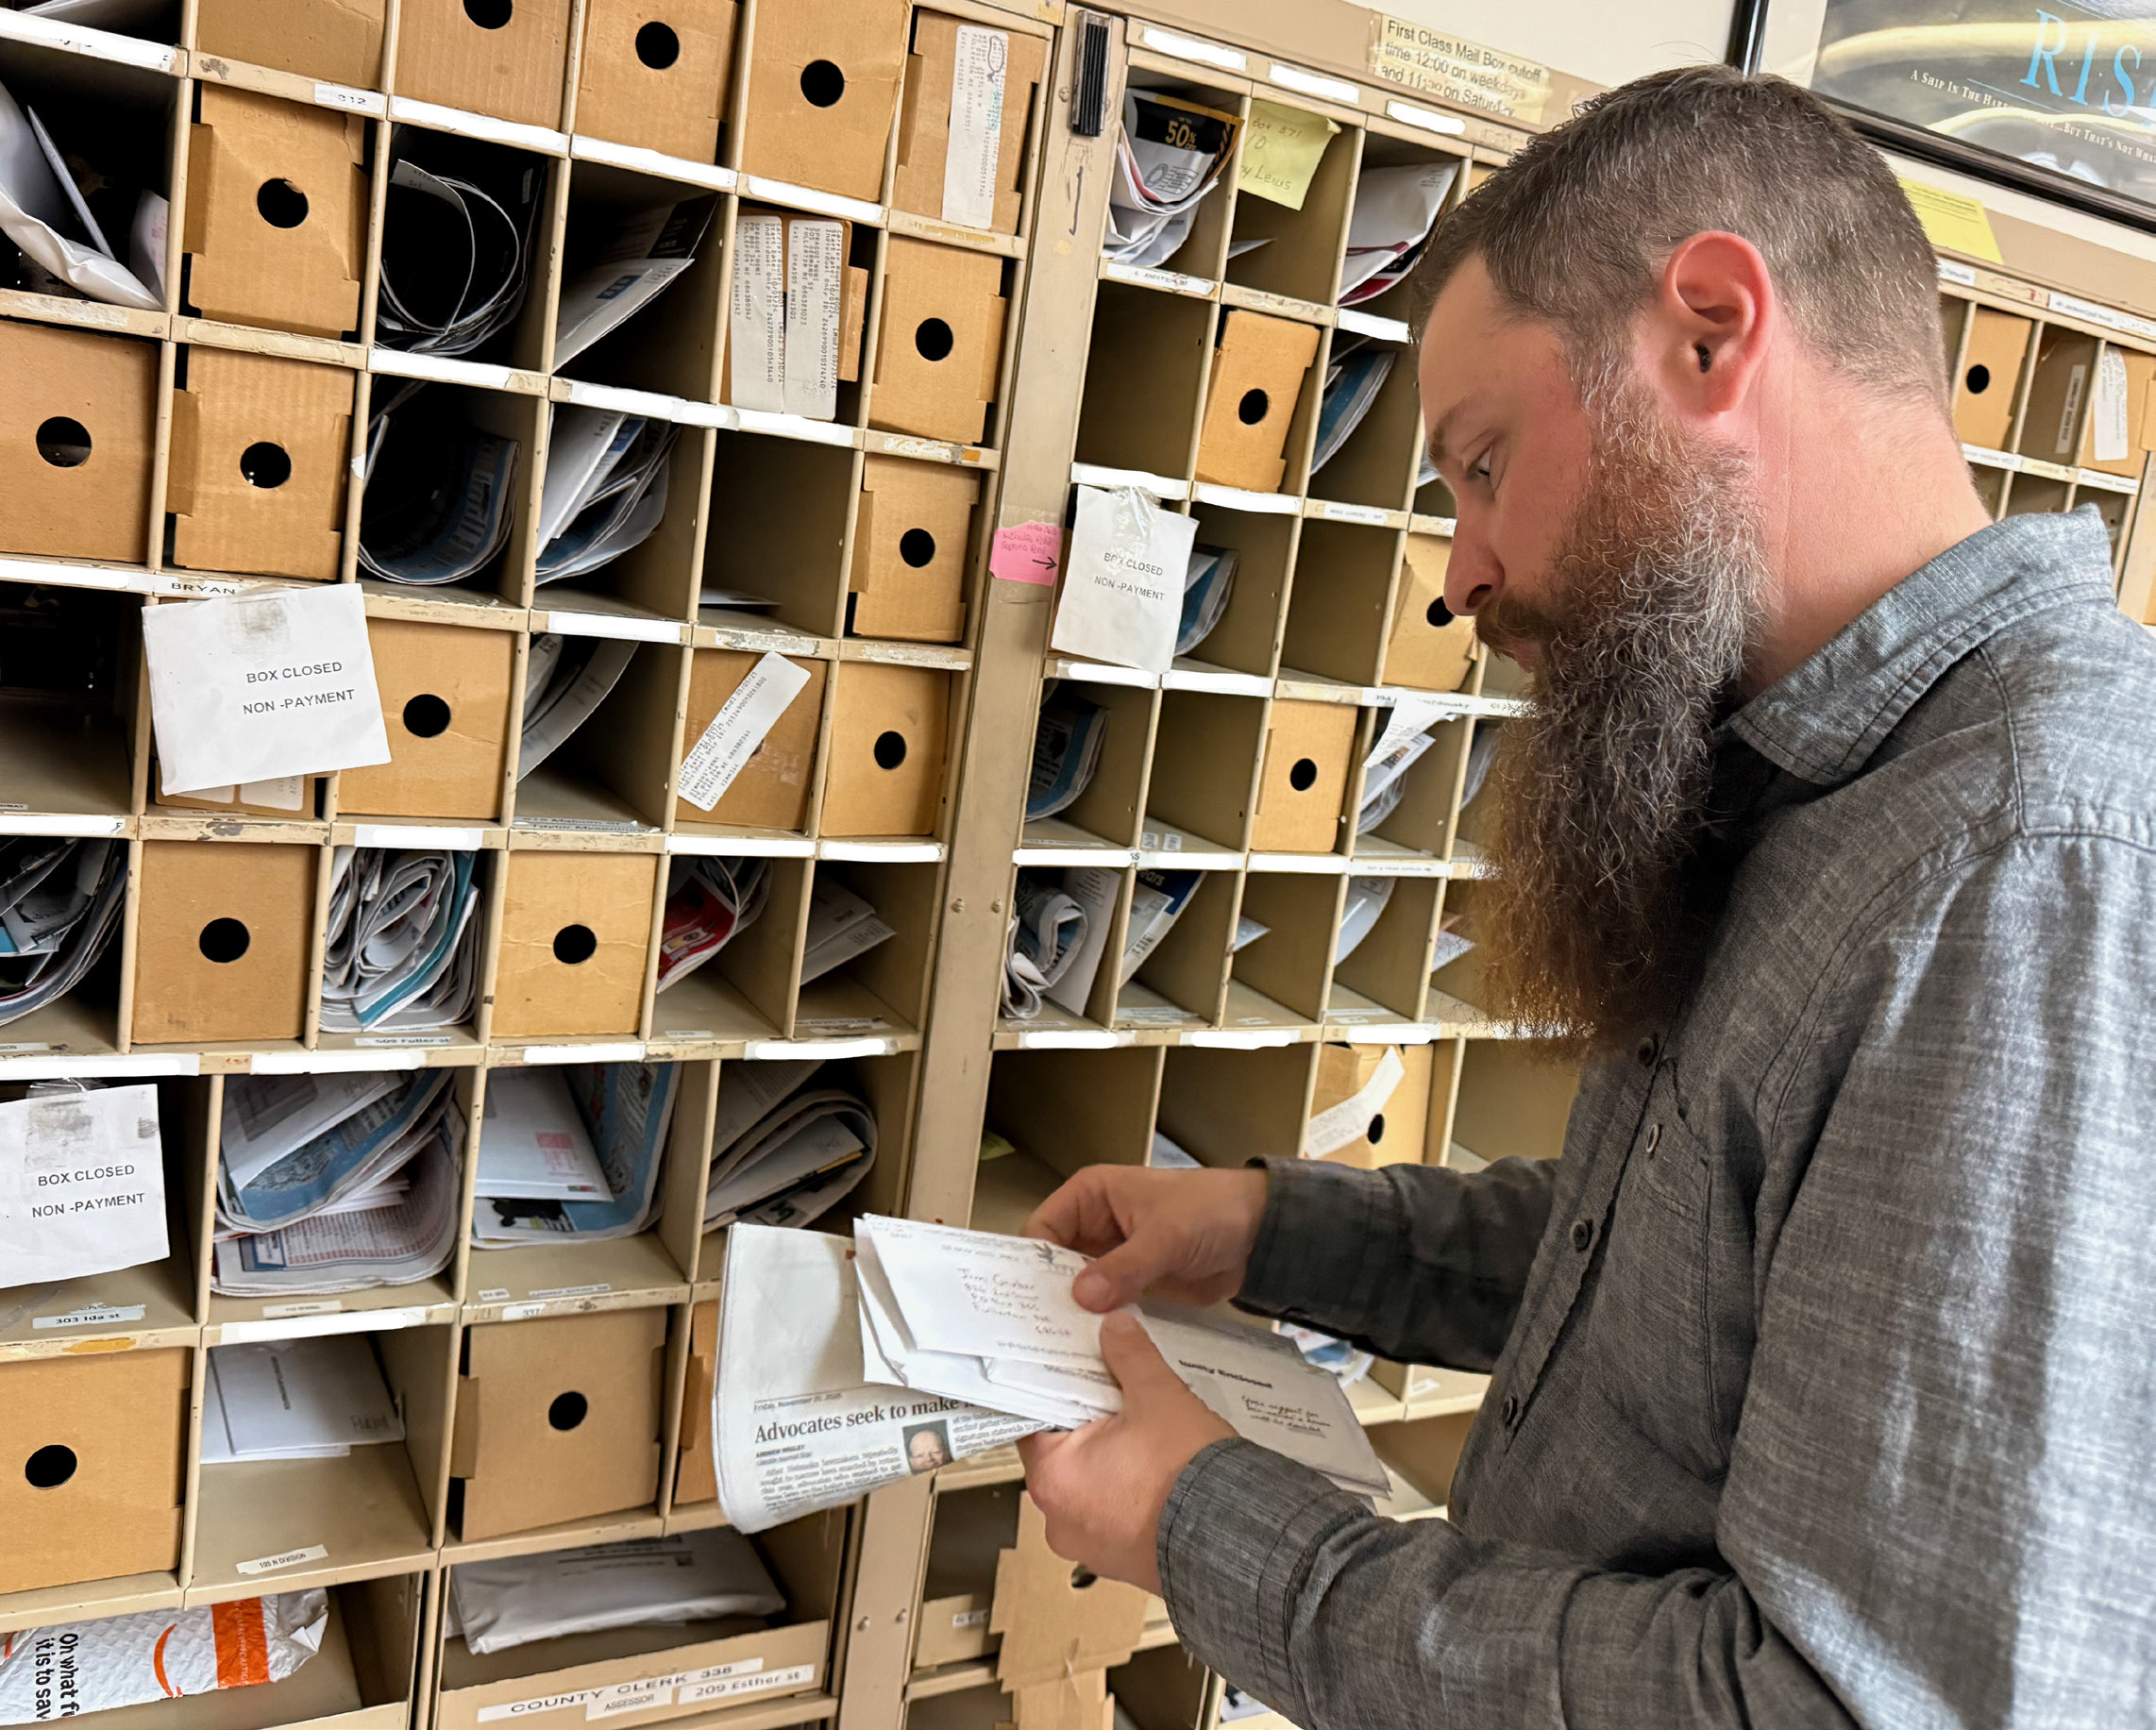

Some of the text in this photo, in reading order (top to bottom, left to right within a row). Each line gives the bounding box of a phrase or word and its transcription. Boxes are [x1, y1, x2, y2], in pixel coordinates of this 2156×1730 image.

[969, 33, 978, 76] FULLERTON
[1385, 42, 1411, 62] time
[1416, 52, 1449, 75] 12:00
[1451, 67, 1467, 79] on
[1388, 20, 1541, 83] First Class Mail Box cutoff
[1381, 64, 1404, 82] and
[1443, 85, 1459, 100] on
[1911, 69, 1919, 81] A
[1921, 73, 1945, 90] SHIP
[1947, 81, 1959, 94] IN
[1962, 86, 1980, 104] THE
[2115, 141, 2133, 156] NOT
[1278, 126, 1303, 139] 371
[1255, 164, 1291, 191] Lewis
[749, 222, 755, 233] PO
[800, 227, 809, 269] FULLERTON
[823, 228, 832, 275] Individual
[744, 266, 750, 277] NE
[801, 272, 808, 281] NE
[1103, 552, 1164, 577] BOX CLOSED
[171, 581, 236, 596] BRYAN
[1094, 576, 1115, 589] NON
[246, 661, 343, 683] BOX CLOSED
[243, 688, 355, 715] NON -PAYMENT
[679, 756, 707, 791] Individual
[696, 768, 723, 801] FULLERTON
[38, 1165, 135, 1186] BOX CLOSED
[32, 1193, 145, 1218] NON -PAYMENT
[755, 1415, 845, 1444] Advocates
[846, 1406, 885, 1428] seek
[889, 1402, 907, 1419] to
[911, 1397, 961, 1417] make
[278, 1553, 307, 1564] DIVISION
[36, 1638, 57, 1720] it is to sav
[59, 1633, 80, 1719] Oh what fu
[511, 1665, 733, 1714] COUNTY CLERK 338
[695, 1670, 801, 1698] 209 Esther st
[604, 1693, 655, 1712] ASSESSOR
